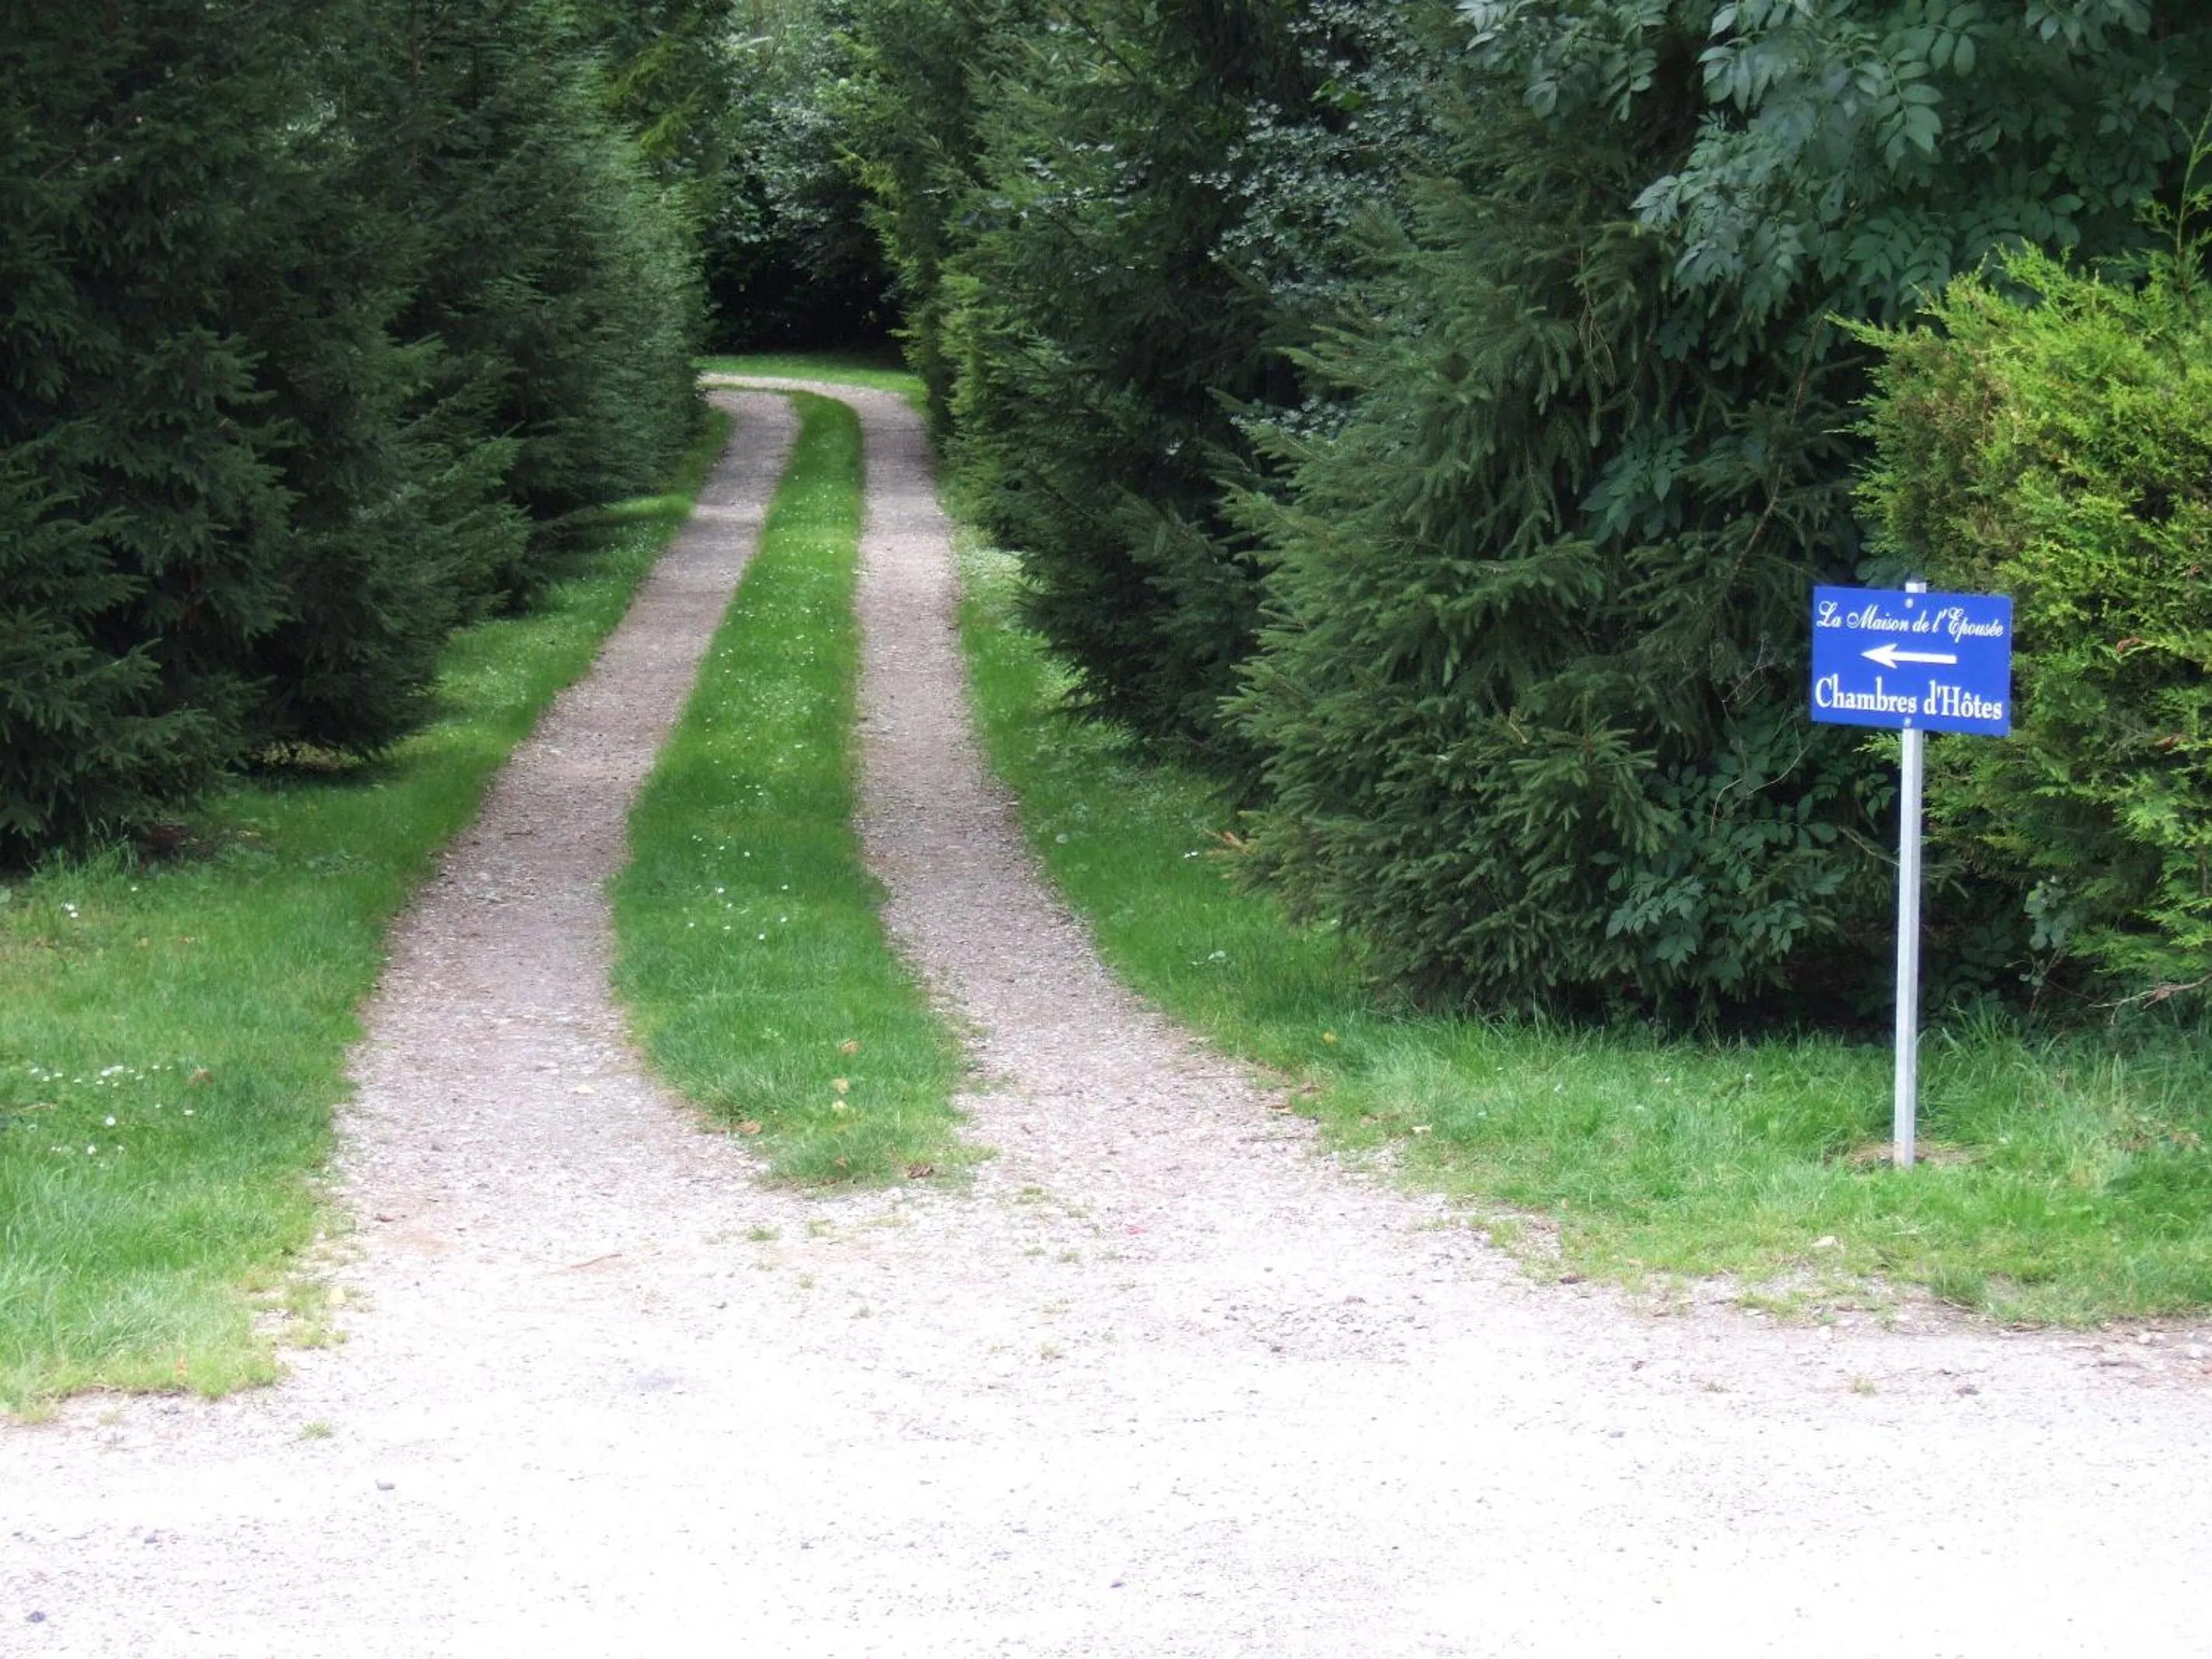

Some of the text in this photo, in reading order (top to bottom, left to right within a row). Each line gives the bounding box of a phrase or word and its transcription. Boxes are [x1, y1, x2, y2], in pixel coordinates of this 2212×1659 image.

[1817, 601, 1842, 628] La
[1847, 604, 1909, 631] Maison
[1912, 610, 1929, 634] de
[1816, 673, 2002, 719] Chambres d'Hôtes
